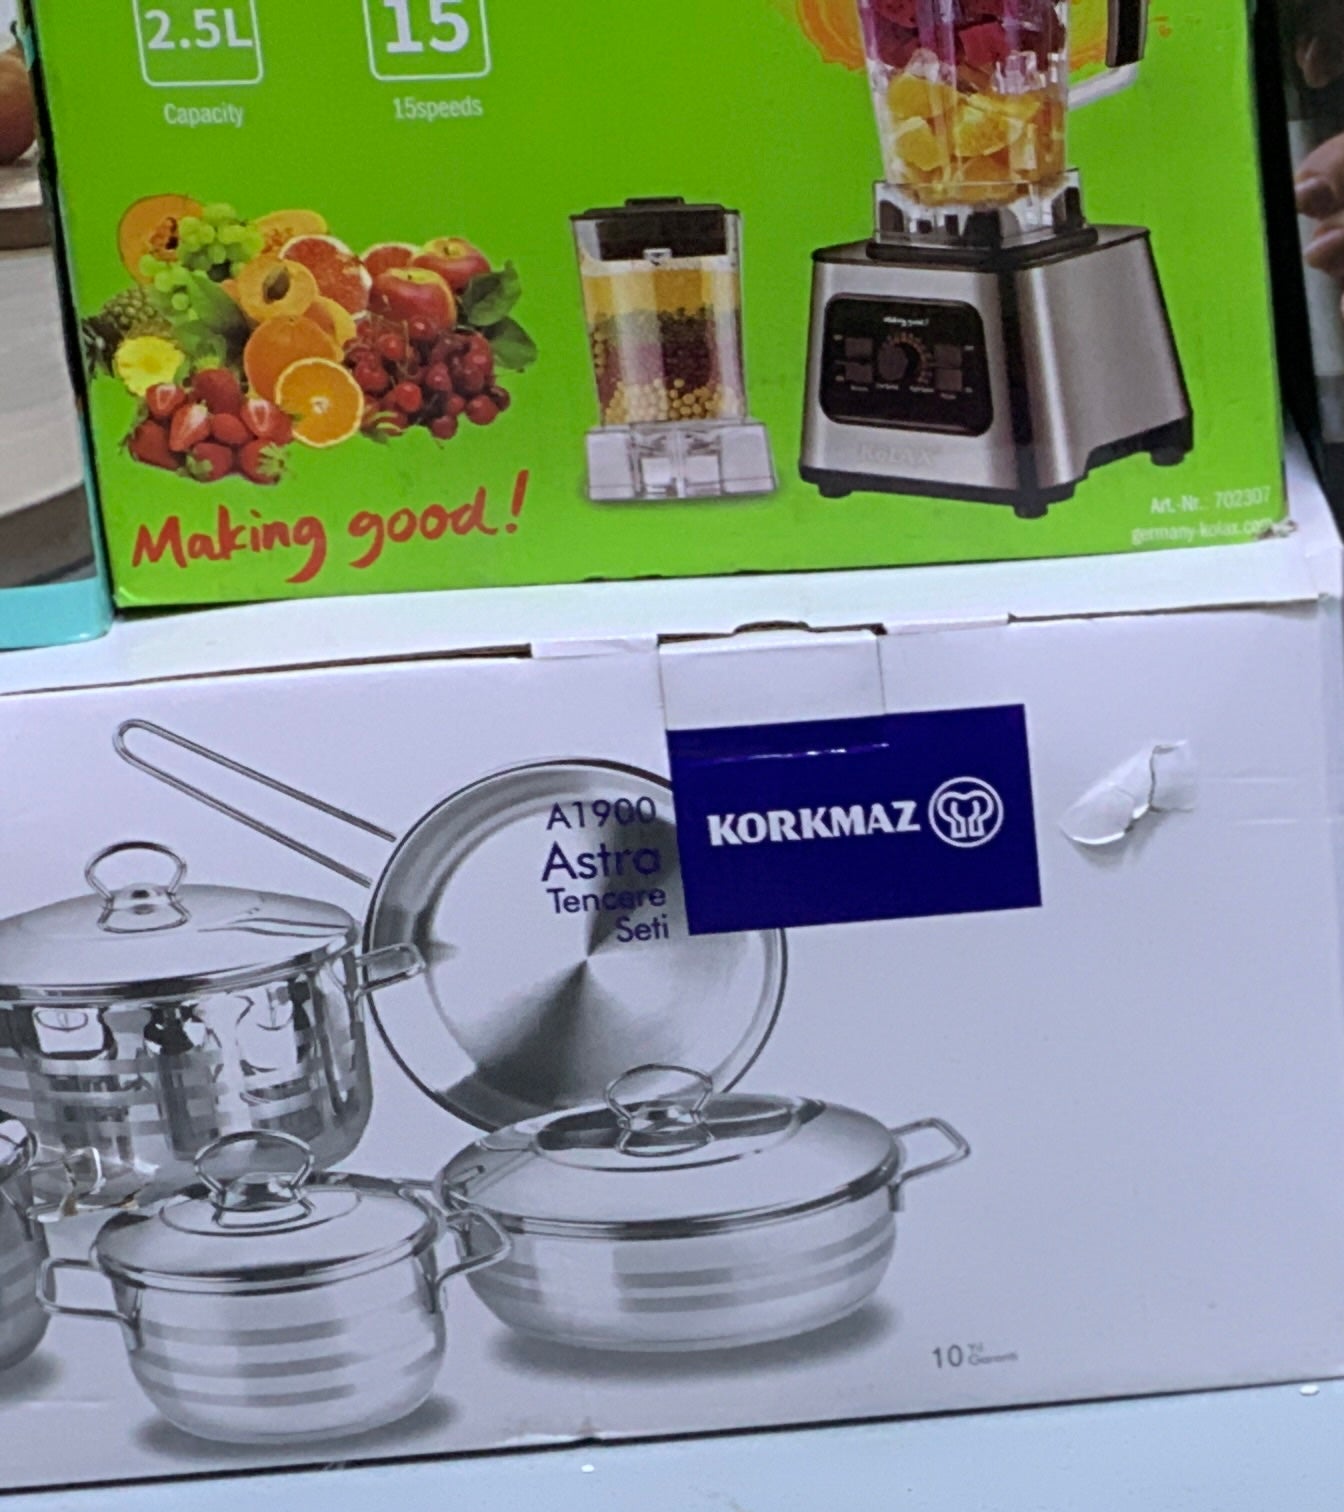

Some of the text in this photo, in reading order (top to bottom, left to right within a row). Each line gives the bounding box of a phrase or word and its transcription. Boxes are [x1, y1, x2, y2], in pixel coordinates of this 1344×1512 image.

[145, 5, 253, 51] 2.5L
[385, 0, 470, 54] 15
[164, 103, 244, 128] Capacity
[393, 96, 483, 122] 15speeds
[1214, 485, 1271, 510] 702307
[132, 469, 530, 583] Making good!
[546, 796, 657, 831] A1900
[707, 800, 920, 847] KORKMAZ
[541, 840, 661, 882] Astra
[546, 884, 667, 915] Tencere
[615, 914, 670, 943] Seti
[932, 1343, 963, 1369] 10
